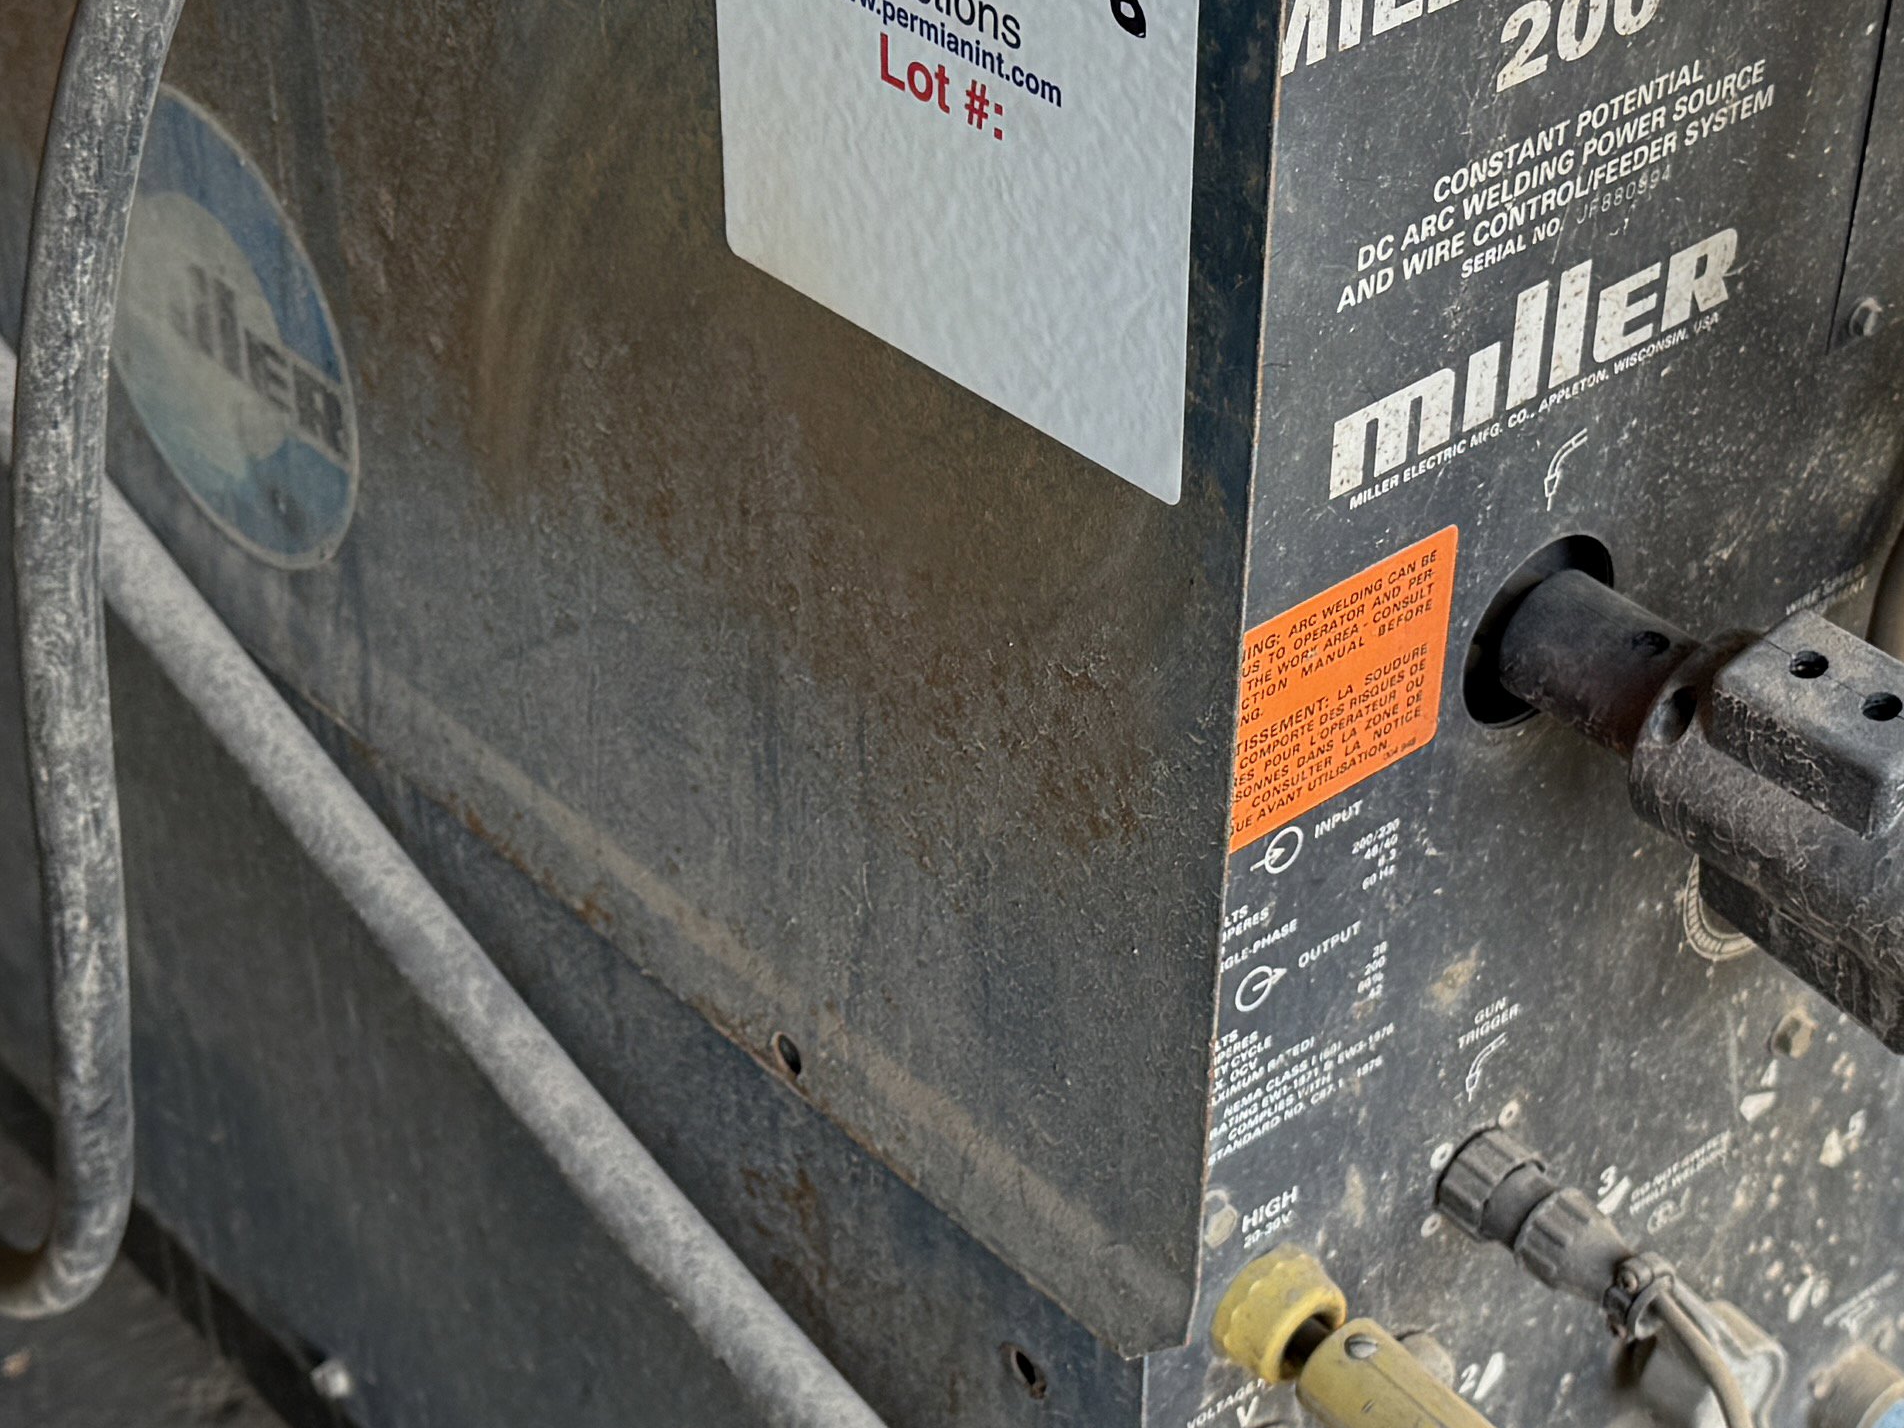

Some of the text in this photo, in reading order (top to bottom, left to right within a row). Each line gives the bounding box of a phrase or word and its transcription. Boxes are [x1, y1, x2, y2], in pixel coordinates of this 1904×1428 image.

[879, 32, 1005, 142] Lot #:
[1433, 60, 1704, 204] CONSTANT POTENTIAL
[1357, 59, 1766, 273] DC ARC WELDING POWER SOURCE
[1336, 84, 1775, 314] AND WIRE CONTROL/FEEDER SYSTEM
[1460, 238, 1527, 280] SERIAL
[1532, 218, 1565, 248] NO.
[1349, 474, 1399, 510] MILLER
[1402, 437, 1468, 484] ELECTRIC
[1288, 613, 1317, 638] ARC
[1321, 578, 1383, 619] WELDING
[1387, 560, 1416, 586] CAN
[1421, 549, 1438, 568] BE
[1246, 670, 1272, 691] THE
[1323, 625, 1360, 652] AREA
[1373, 582, 1435, 624] CONSULT
[1269, 646, 1286, 664] TO
[1293, 603, 1366, 651] OPERATOR
[1372, 586, 1401, 609] AND
[1300, 636, 1365, 678] MANUAL
[1378, 598, 1433, 637] BEFORE
[1337, 684, 1354, 700] LA
[1364, 643, 1428, 686] SOUDURE
[1239, 658, 1426, 770] COMPORTE DES RISQUES DE
[1264, 743, 1301, 772] POUR
[1405, 675, 1425, 694] OU
[1297, 741, 1334, 769] DANS
[1341, 727, 1358, 744] LA
[1364, 704, 1399, 732] ZONE
[1406, 689, 1423, 707] DE
[1252, 756, 1333, 808] CONSULTER
[1345, 740, 1361, 757] LA
[1372, 706, 1422, 740] NOTICE
[1257, 787, 1304, 822] AVANT
[1314, 799, 1363, 838] INPUT
[1298, 921, 1361, 968] OUTPUT
[1364, 955, 1387, 977] 200
[1458, 1003, 1521, 1049] TRIGGER
[1475, 996, 1508, 1025] GUN
[1230, 1058, 1258, 1080] OCV
[1231, 1035, 1272, 1066] CYCLE
[1223, 1088, 1264, 1118] NEMA
[1266, 1061, 1308, 1090] CLASS
[1228, 1073, 1331, 1141] COMPLIES WITH
[1208, 1115, 1282, 1166] STANDARD
[1241, 1185, 1299, 1233] HIGH
[1597, 1165, 1617, 1196] 3
[1458, 1363, 1478, 1394] 2
